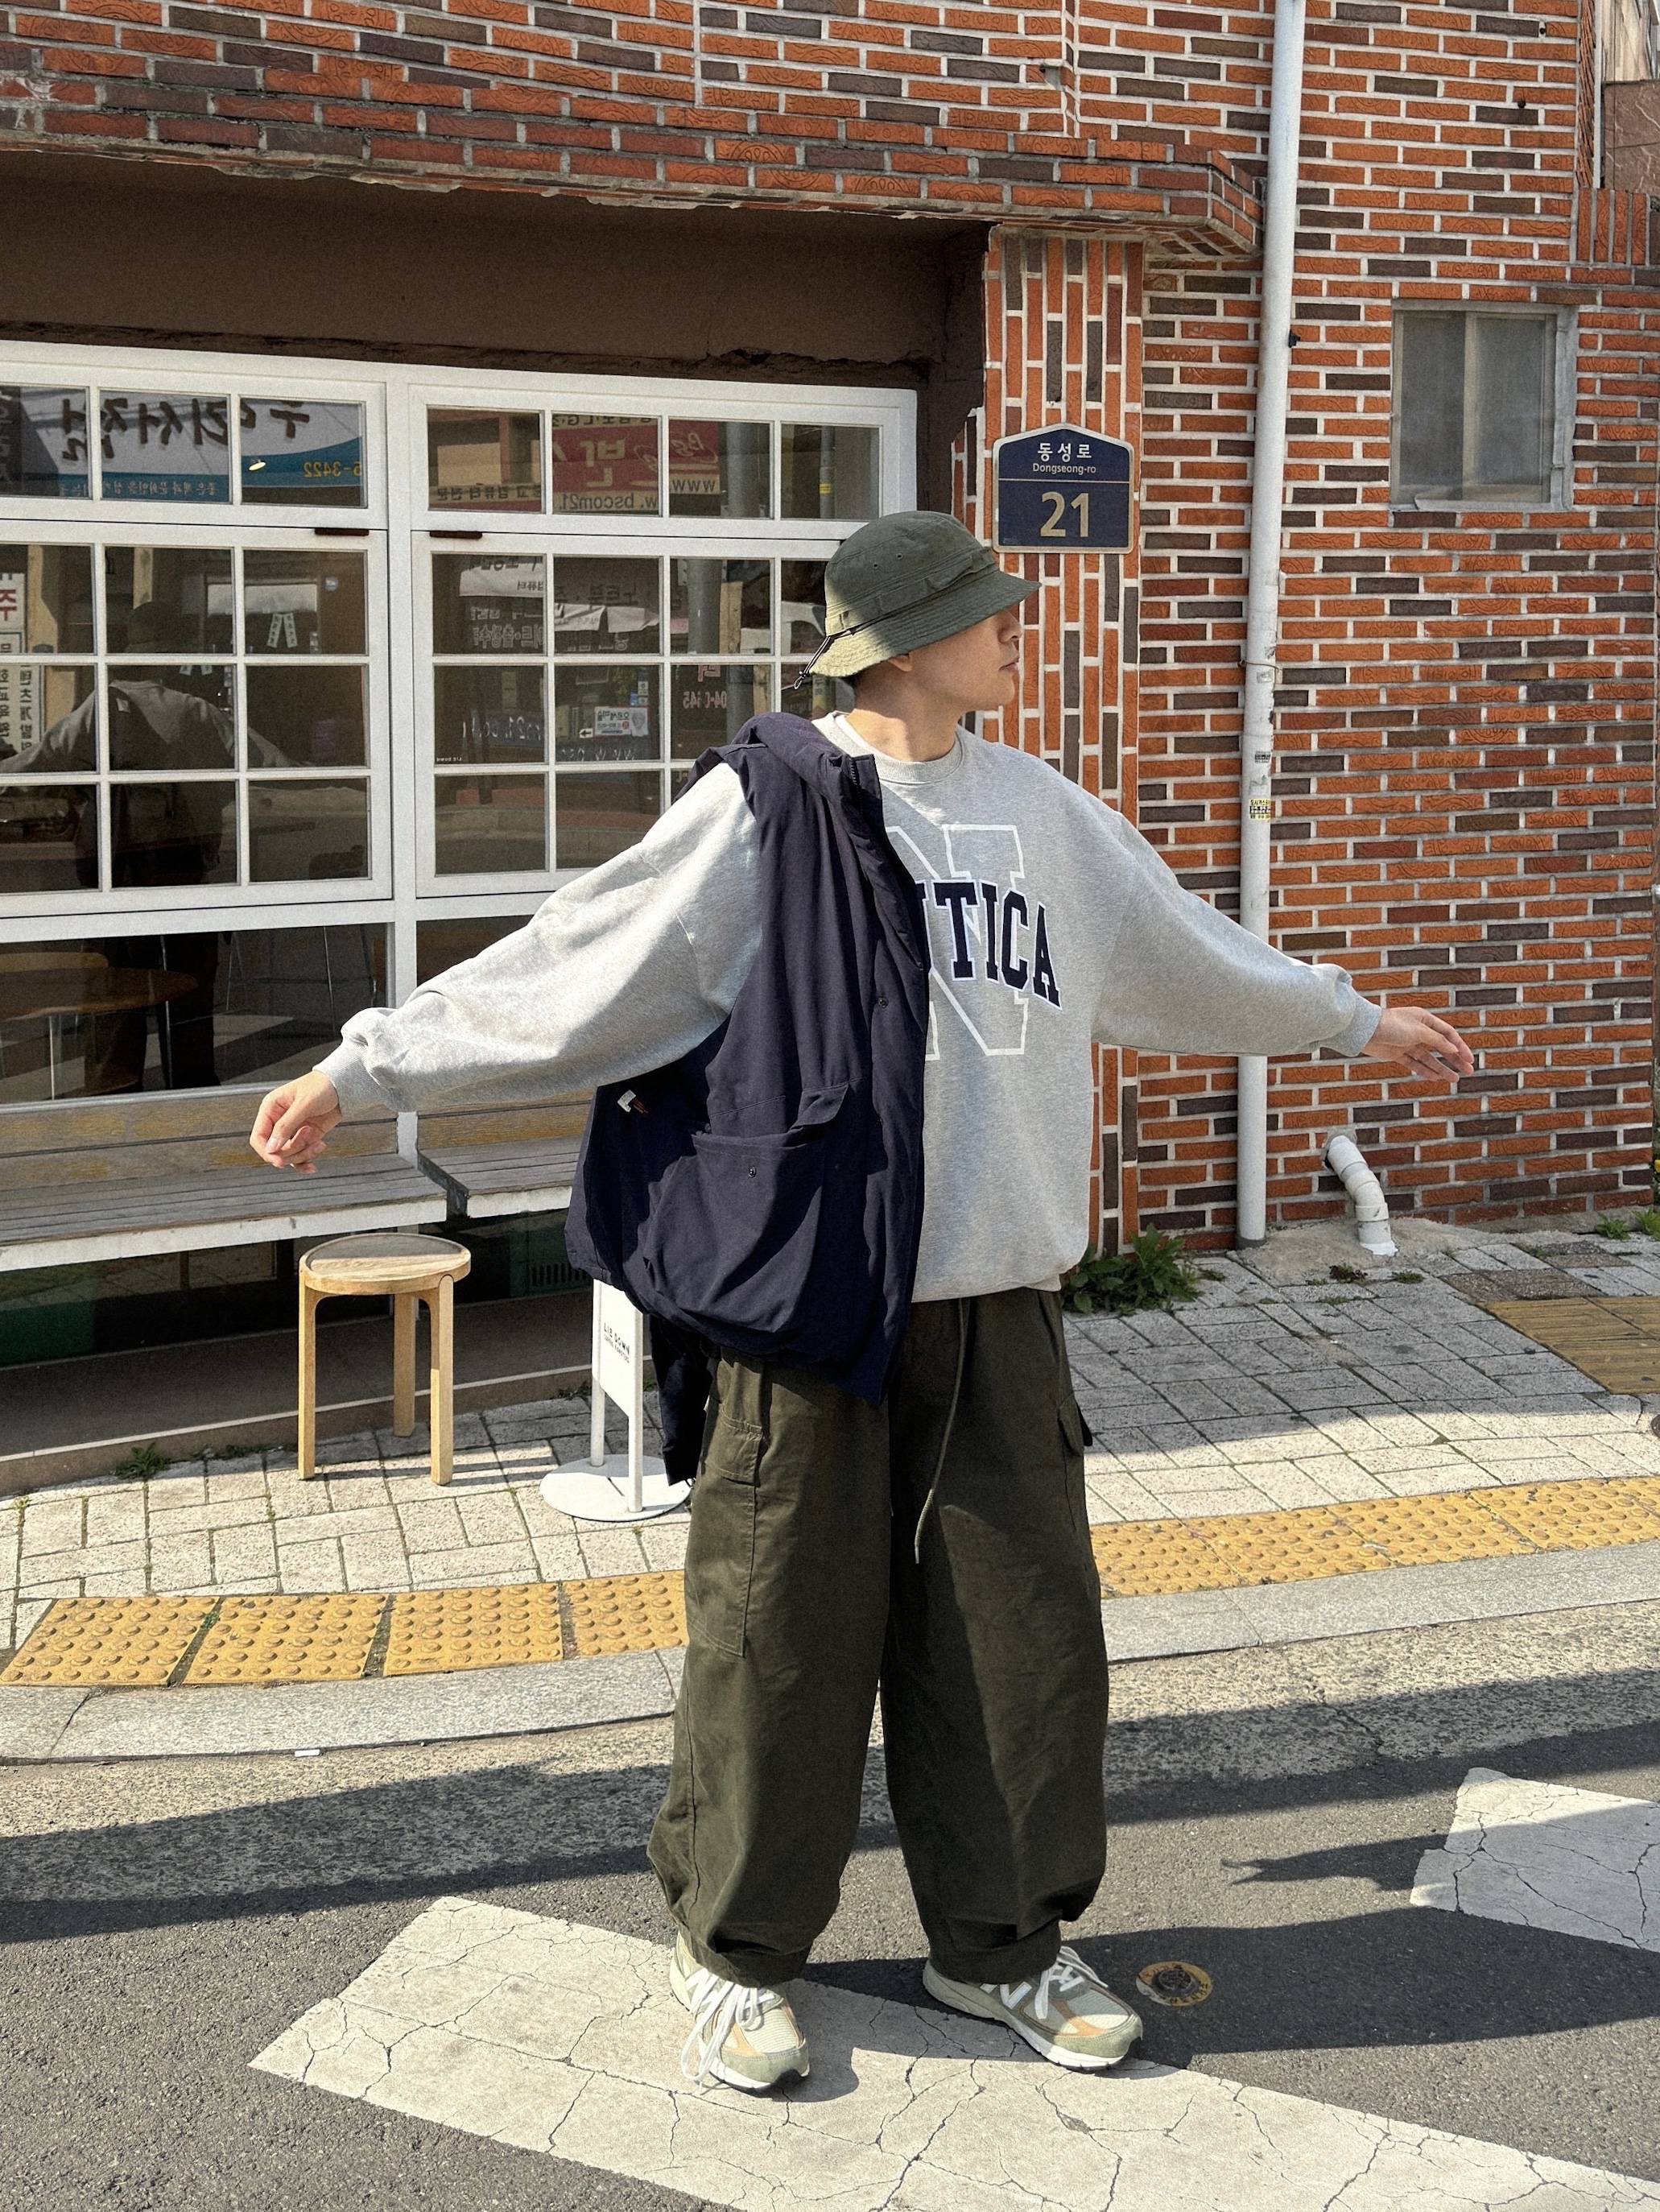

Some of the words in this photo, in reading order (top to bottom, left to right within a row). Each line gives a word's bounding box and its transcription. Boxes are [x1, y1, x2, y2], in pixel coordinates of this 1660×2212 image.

[1037, 443, 1092, 462] 동성로
[1032, 463, 1096, 475] Dongseong-ro
[1039, 491, 1089, 538] 21
